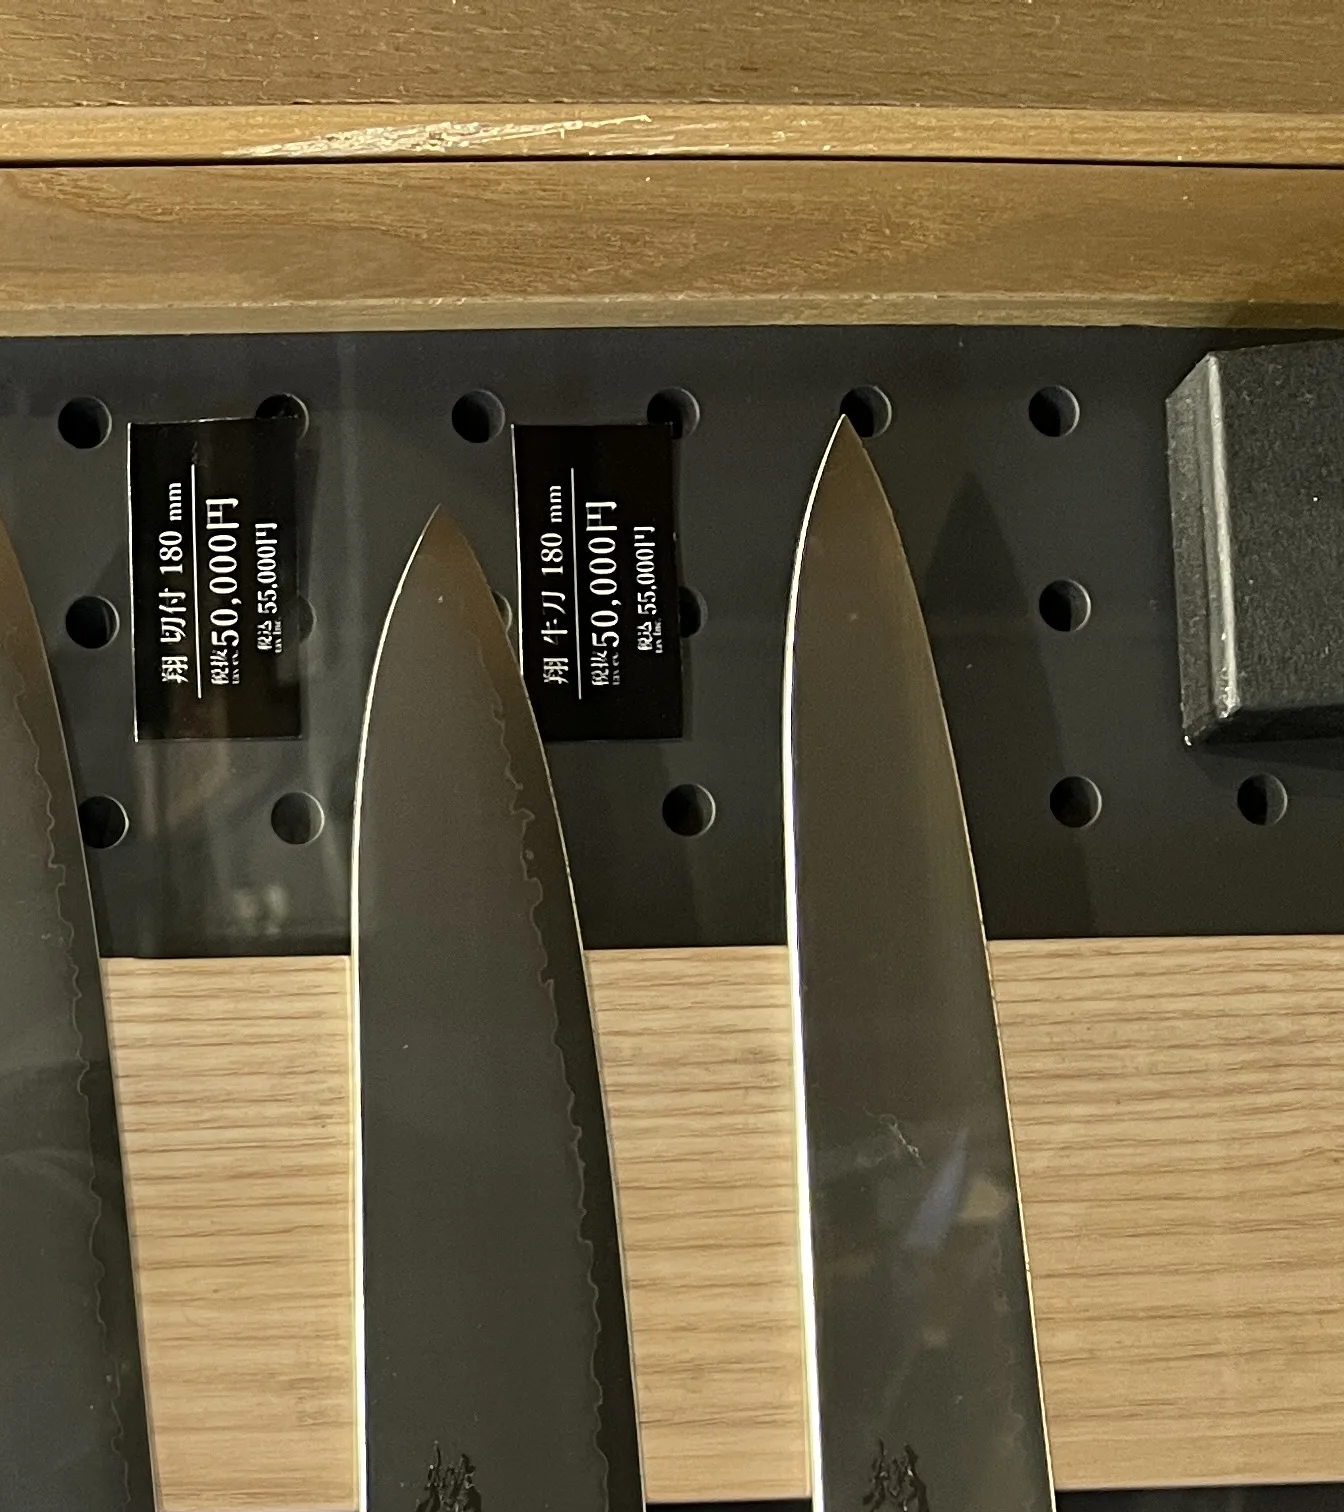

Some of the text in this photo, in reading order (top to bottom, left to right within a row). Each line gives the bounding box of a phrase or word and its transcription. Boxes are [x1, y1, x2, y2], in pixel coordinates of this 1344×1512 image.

[159, 482, 189, 684] 翔 切付 180 mm
[206, 497, 242, 685] 税抜 50,000円
[255, 522, 278, 650] 税込 55,000円
[541, 485, 569, 685] 翔 牛刀 180 mm
[586, 501, 622, 686] 税抜 50,000円
[634, 526, 658, 651] 税込 55,000円
